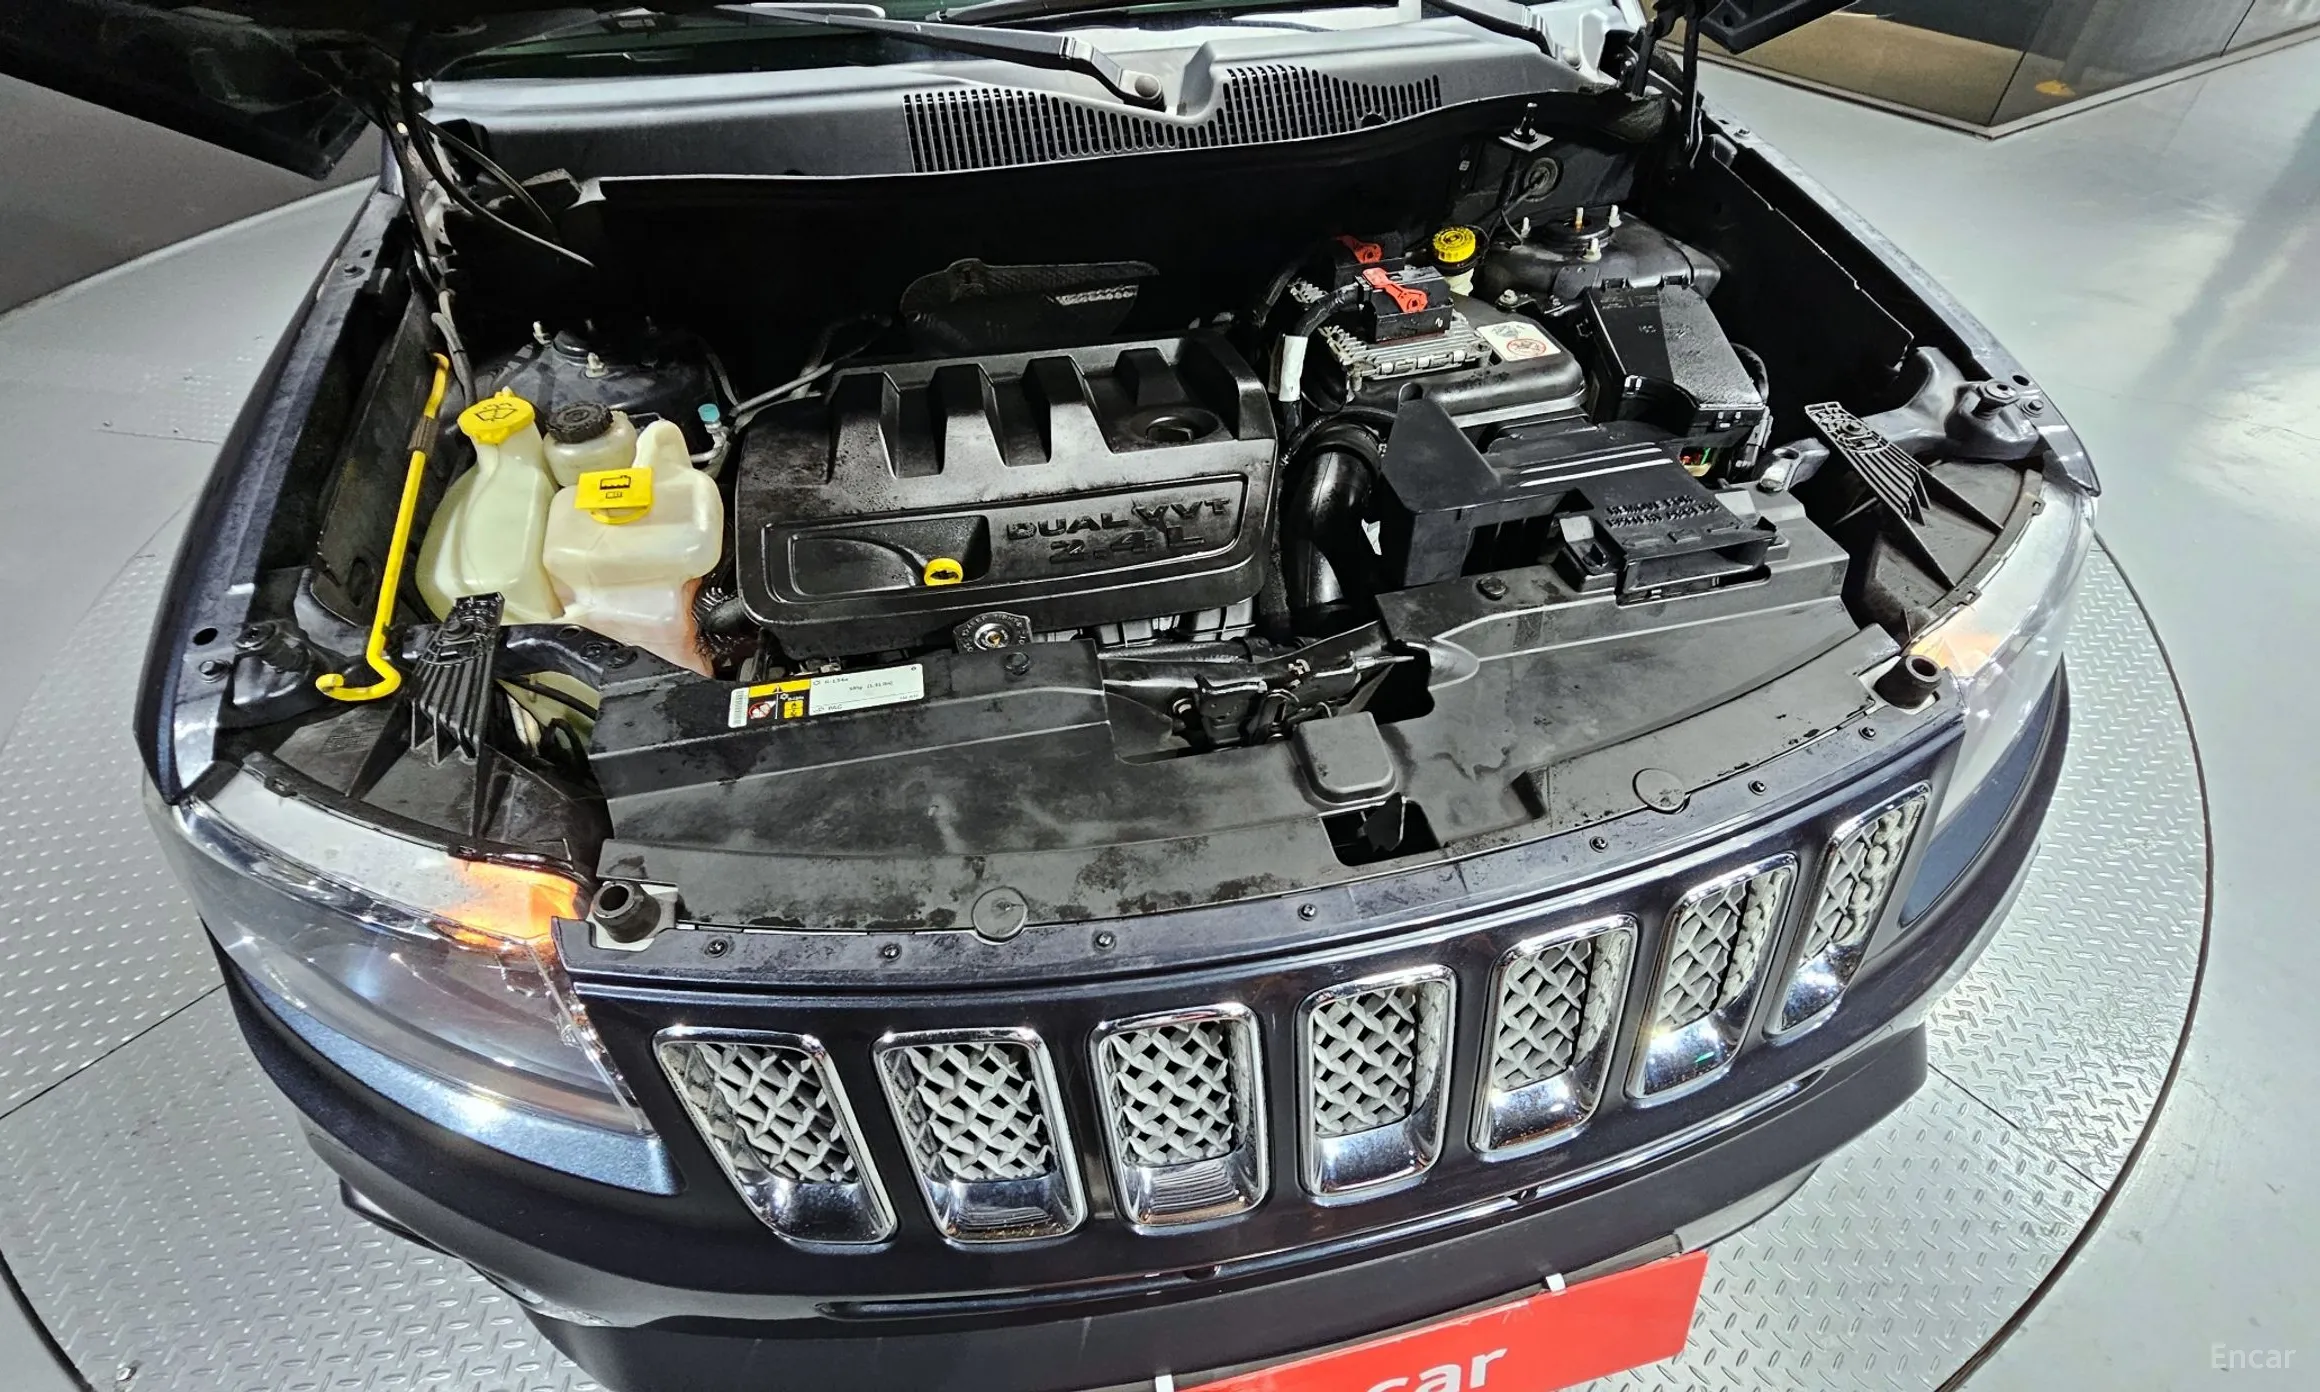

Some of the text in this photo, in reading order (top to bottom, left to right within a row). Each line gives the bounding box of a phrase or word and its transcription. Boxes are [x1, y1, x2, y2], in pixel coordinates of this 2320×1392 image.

[1006, 498, 1231, 541] DUAL VVT
[1049, 526, 1205, 564] 2.4L
